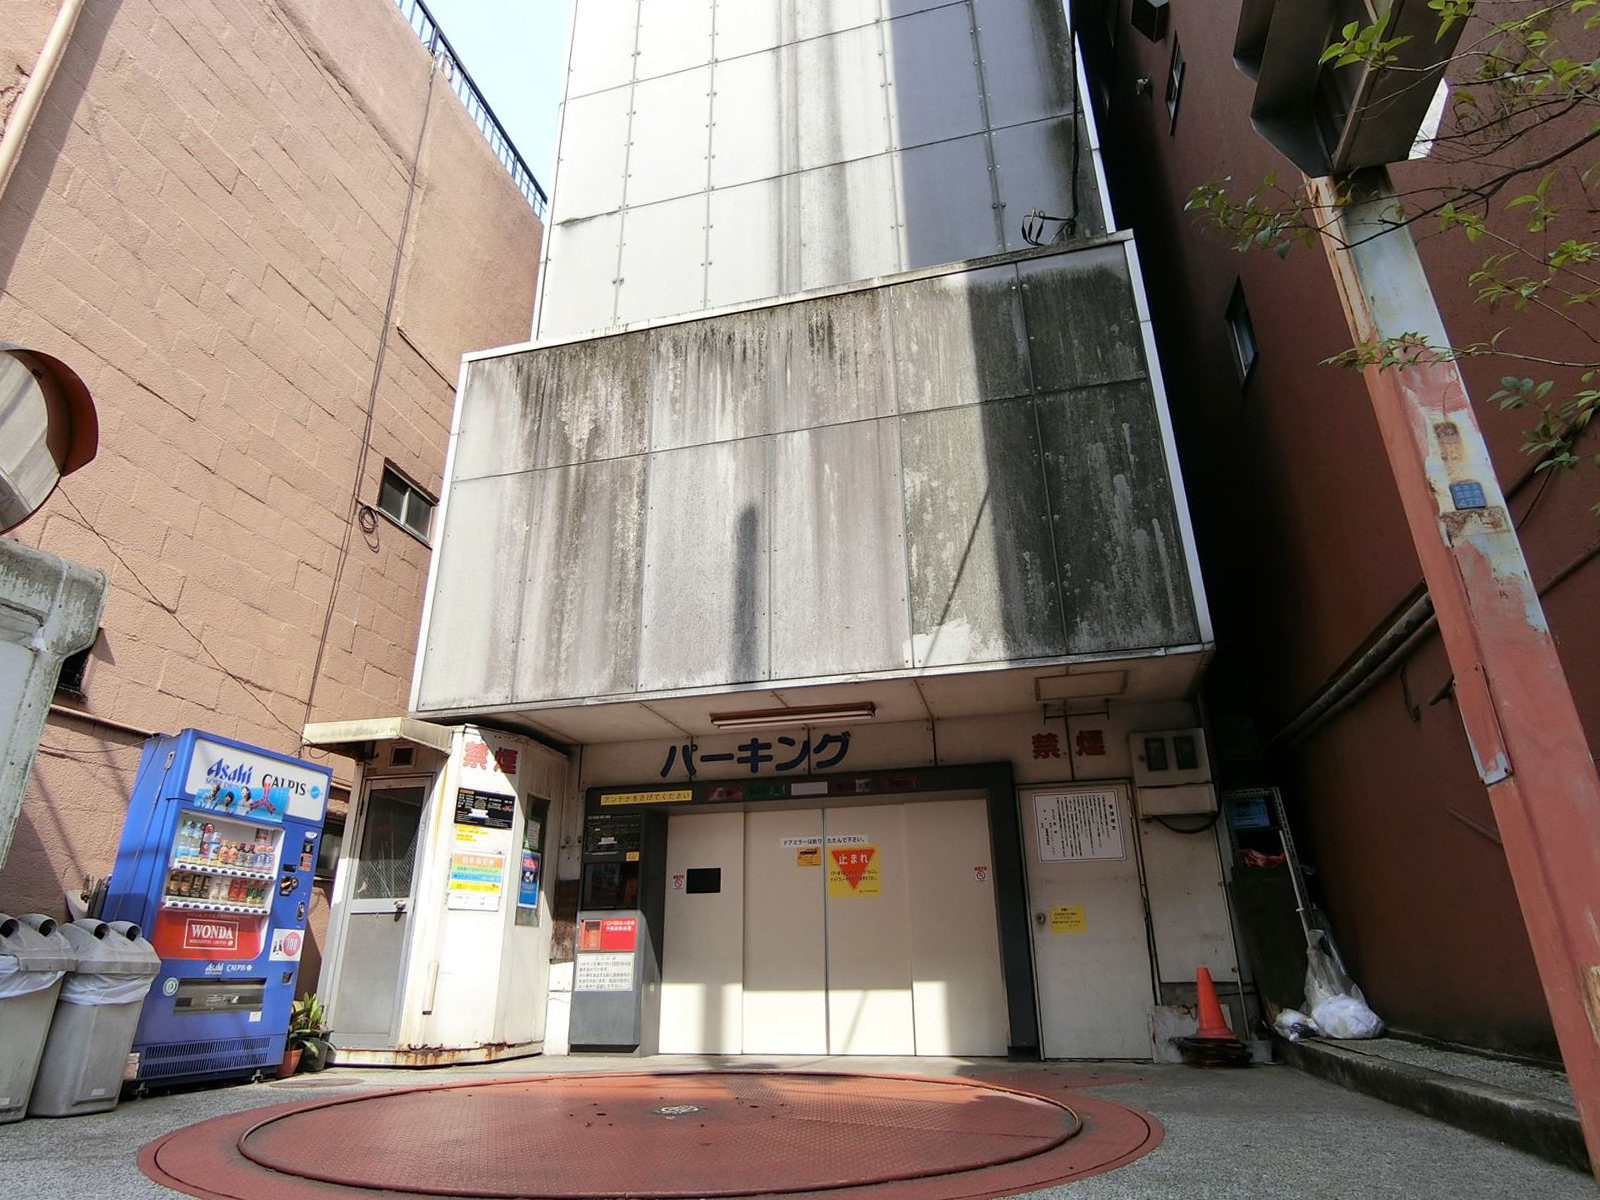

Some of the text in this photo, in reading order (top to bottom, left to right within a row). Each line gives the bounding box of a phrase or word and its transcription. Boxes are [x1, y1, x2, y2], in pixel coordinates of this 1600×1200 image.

[659, 730, 852, 778] パーキング
[1031, 730, 1106, 760] 禁煙
[462, 740, 519, 775] 禁煙
[207, 758, 307, 796] Asahi CALPIS
[603, 791, 691, 803] アンテナをさげてください
[839, 853, 868, 865] 止まれ
[191, 924, 234, 939] WONDA
[226, 963, 246, 972] CALPIS
